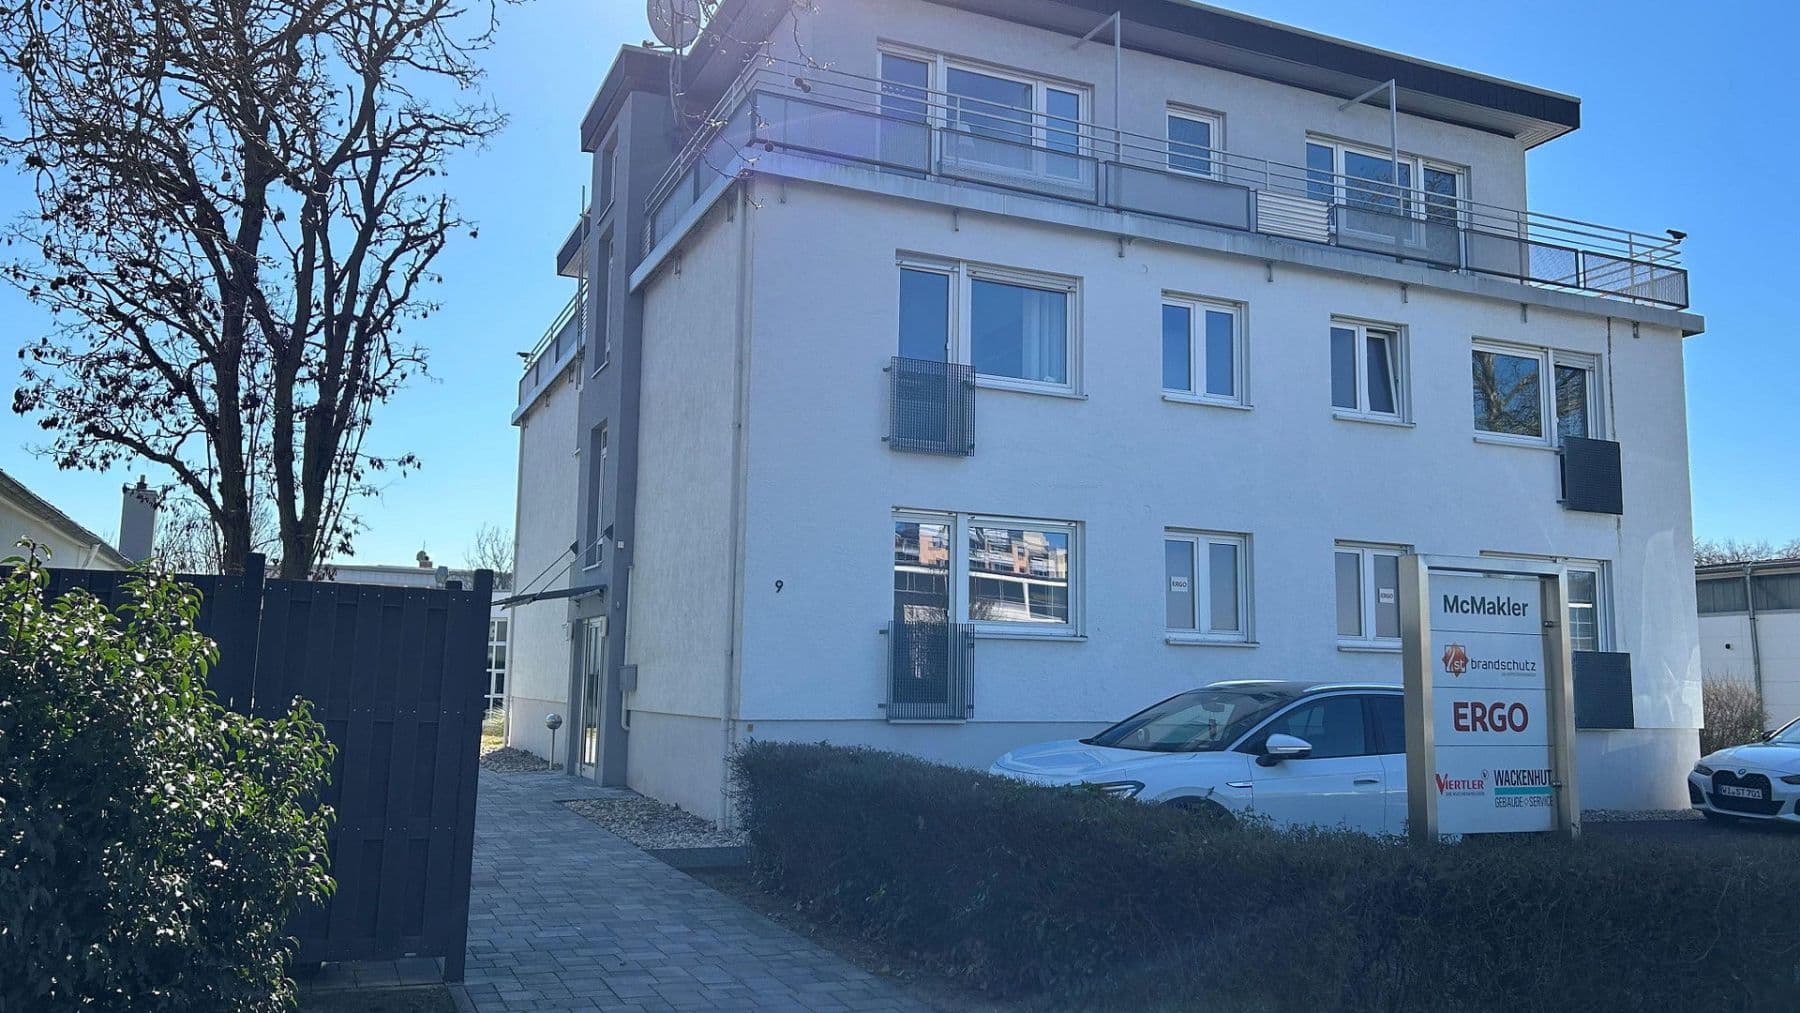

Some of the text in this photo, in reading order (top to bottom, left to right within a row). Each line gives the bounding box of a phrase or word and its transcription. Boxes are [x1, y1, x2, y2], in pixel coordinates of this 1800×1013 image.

[775, 579, 784, 593] 9
[1443, 594, 1529, 617] McMakler
[1470, 658, 1537, 672] brandschutz
[1453, 701, 1529, 733] ERGO
[1435, 773, 1485, 795] VIERTLER
[1493, 769, 1552, 786] WACKENHUT
